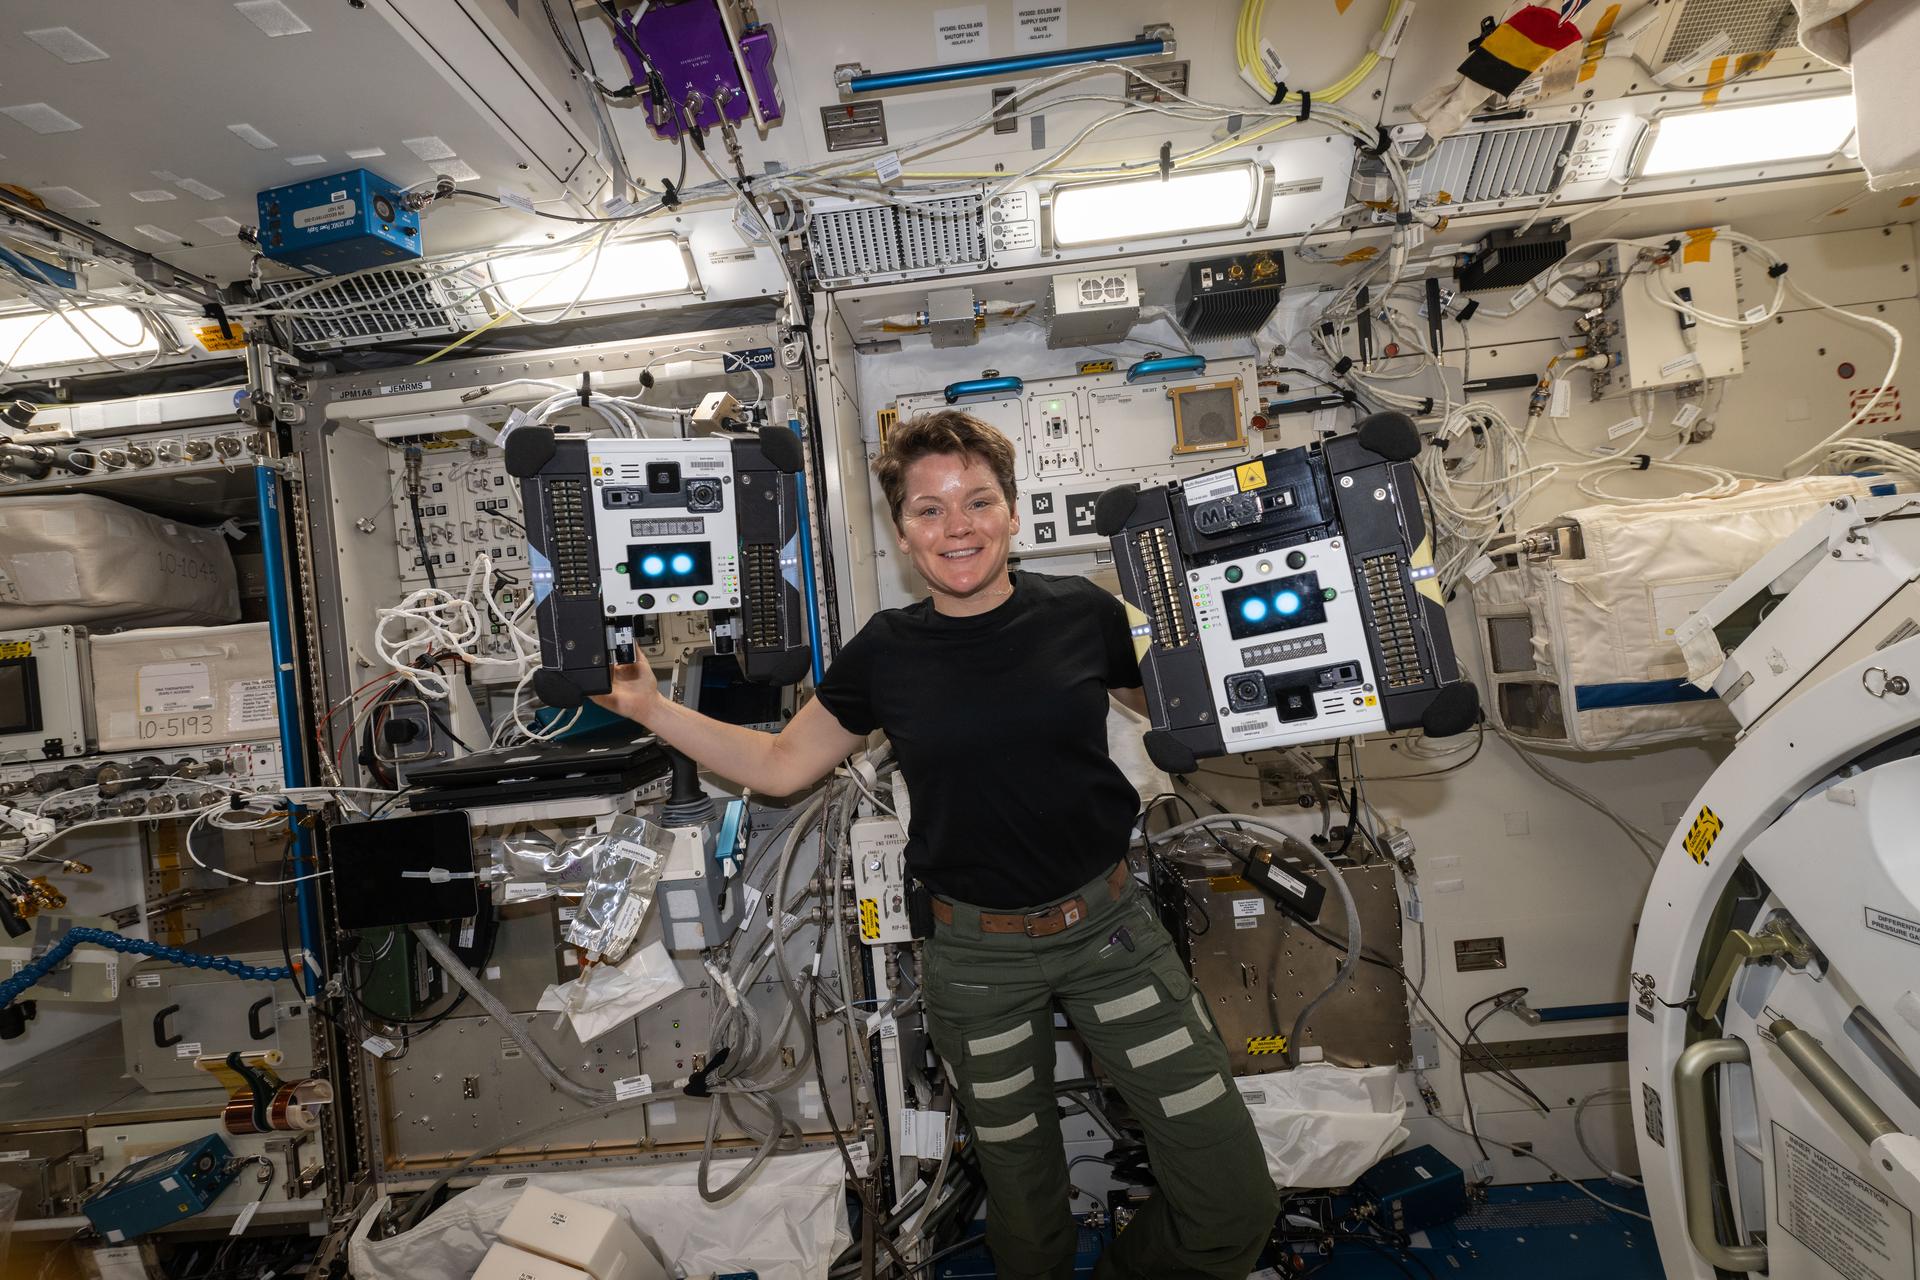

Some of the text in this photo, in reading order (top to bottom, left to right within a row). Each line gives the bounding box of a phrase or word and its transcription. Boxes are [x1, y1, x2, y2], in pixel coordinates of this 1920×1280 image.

[1039, 15, 1060, 23] SHUTOFF
[944, 32, 965, 40] SHUTOFF
[306, 225, 319, 234] Supply
[319, 223, 331, 231] Power
[339, 382, 424, 399] JPM1A6 JEMRMS
[1871, 920, 1908, 937] PRESSURE
[1813, 1151, 1840, 1174] HATCH
[1841, 1170, 1889, 1207] OPERATION
